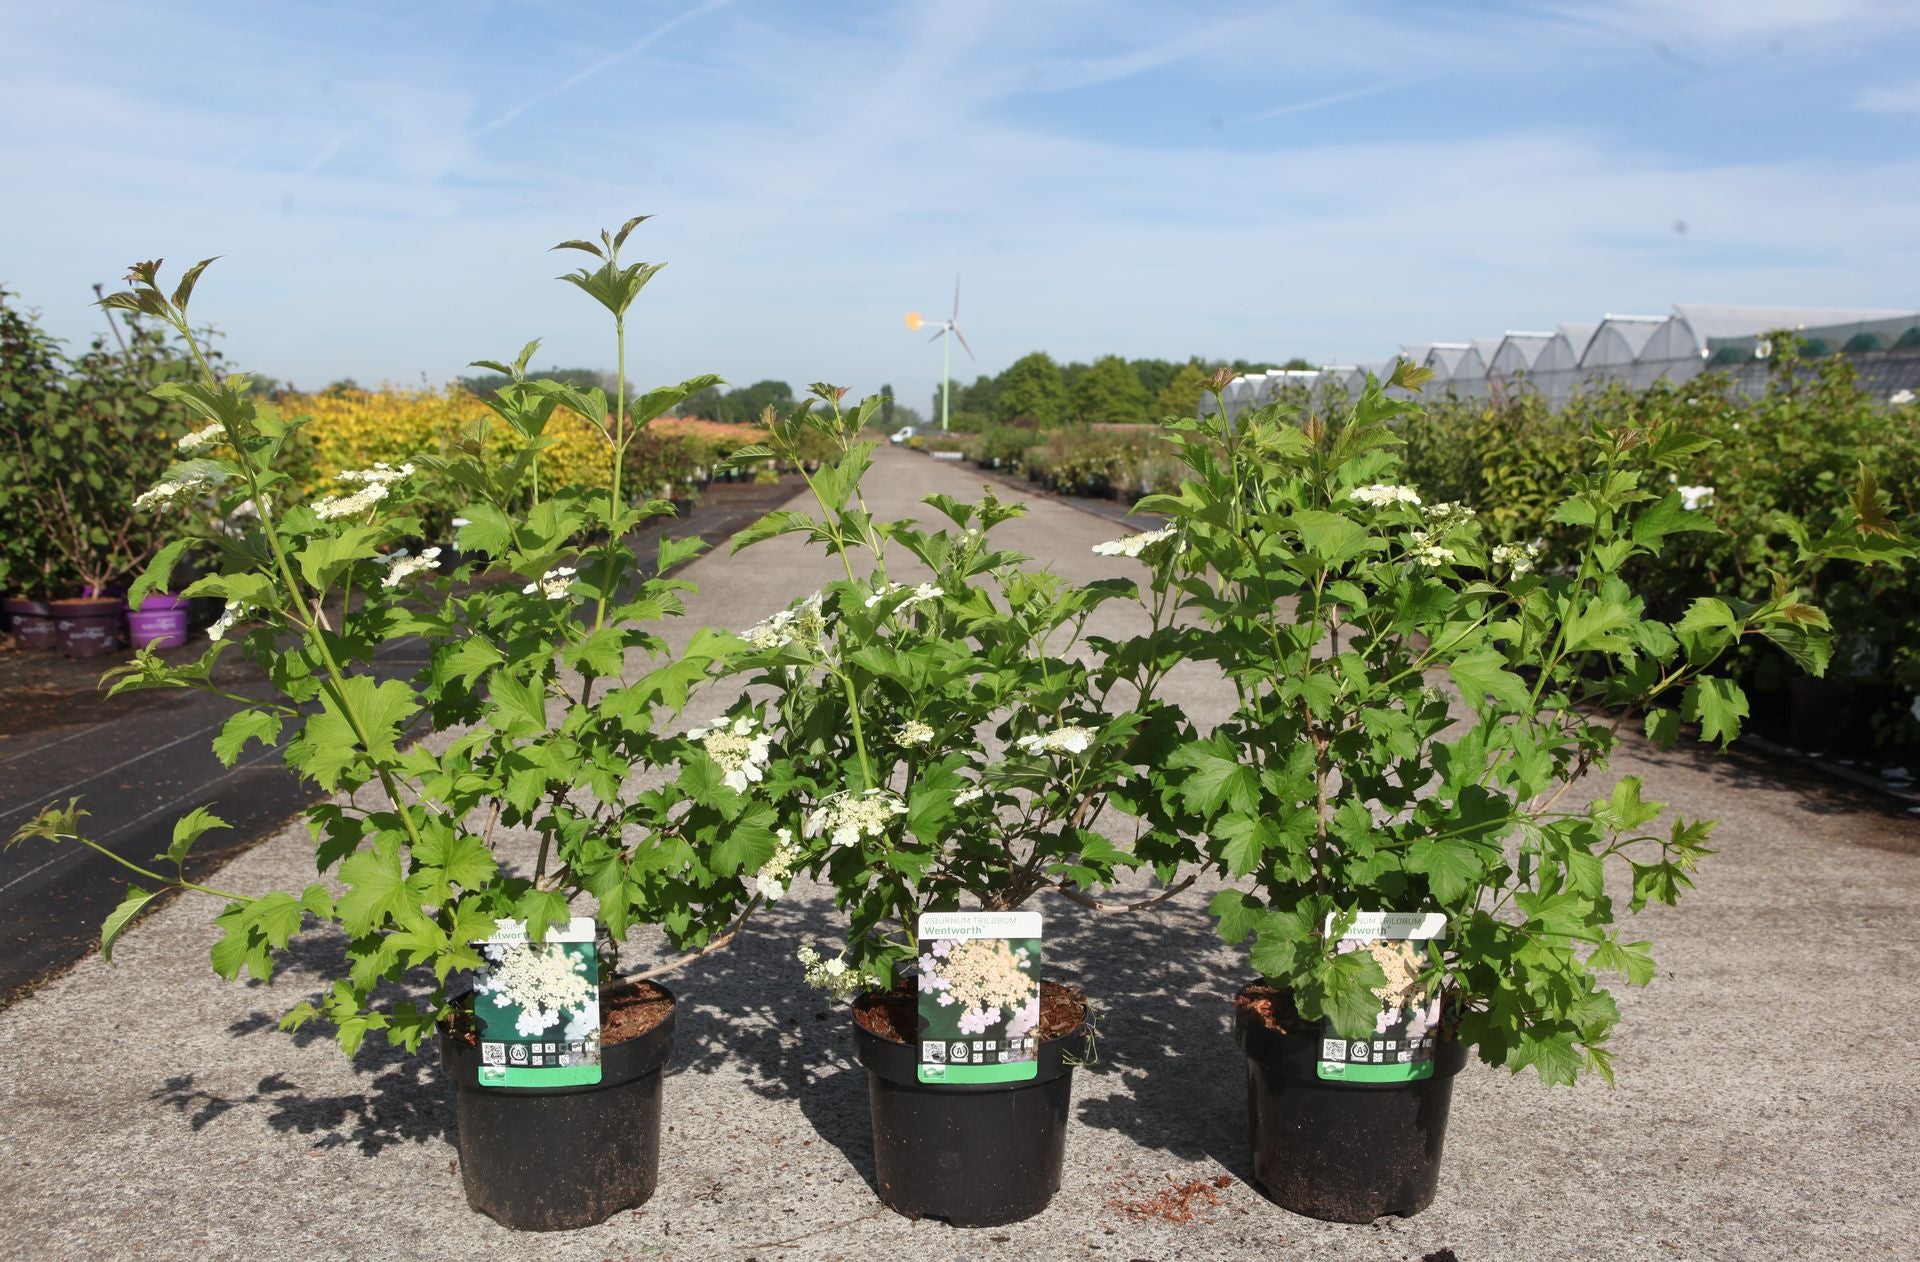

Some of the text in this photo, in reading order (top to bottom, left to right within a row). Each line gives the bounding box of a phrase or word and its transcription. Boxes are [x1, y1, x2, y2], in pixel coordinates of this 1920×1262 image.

[925, 916, 1017, 925] VIBURNUM TRILOBUM
[1379, 917, 1420, 925] TRILOBUM
